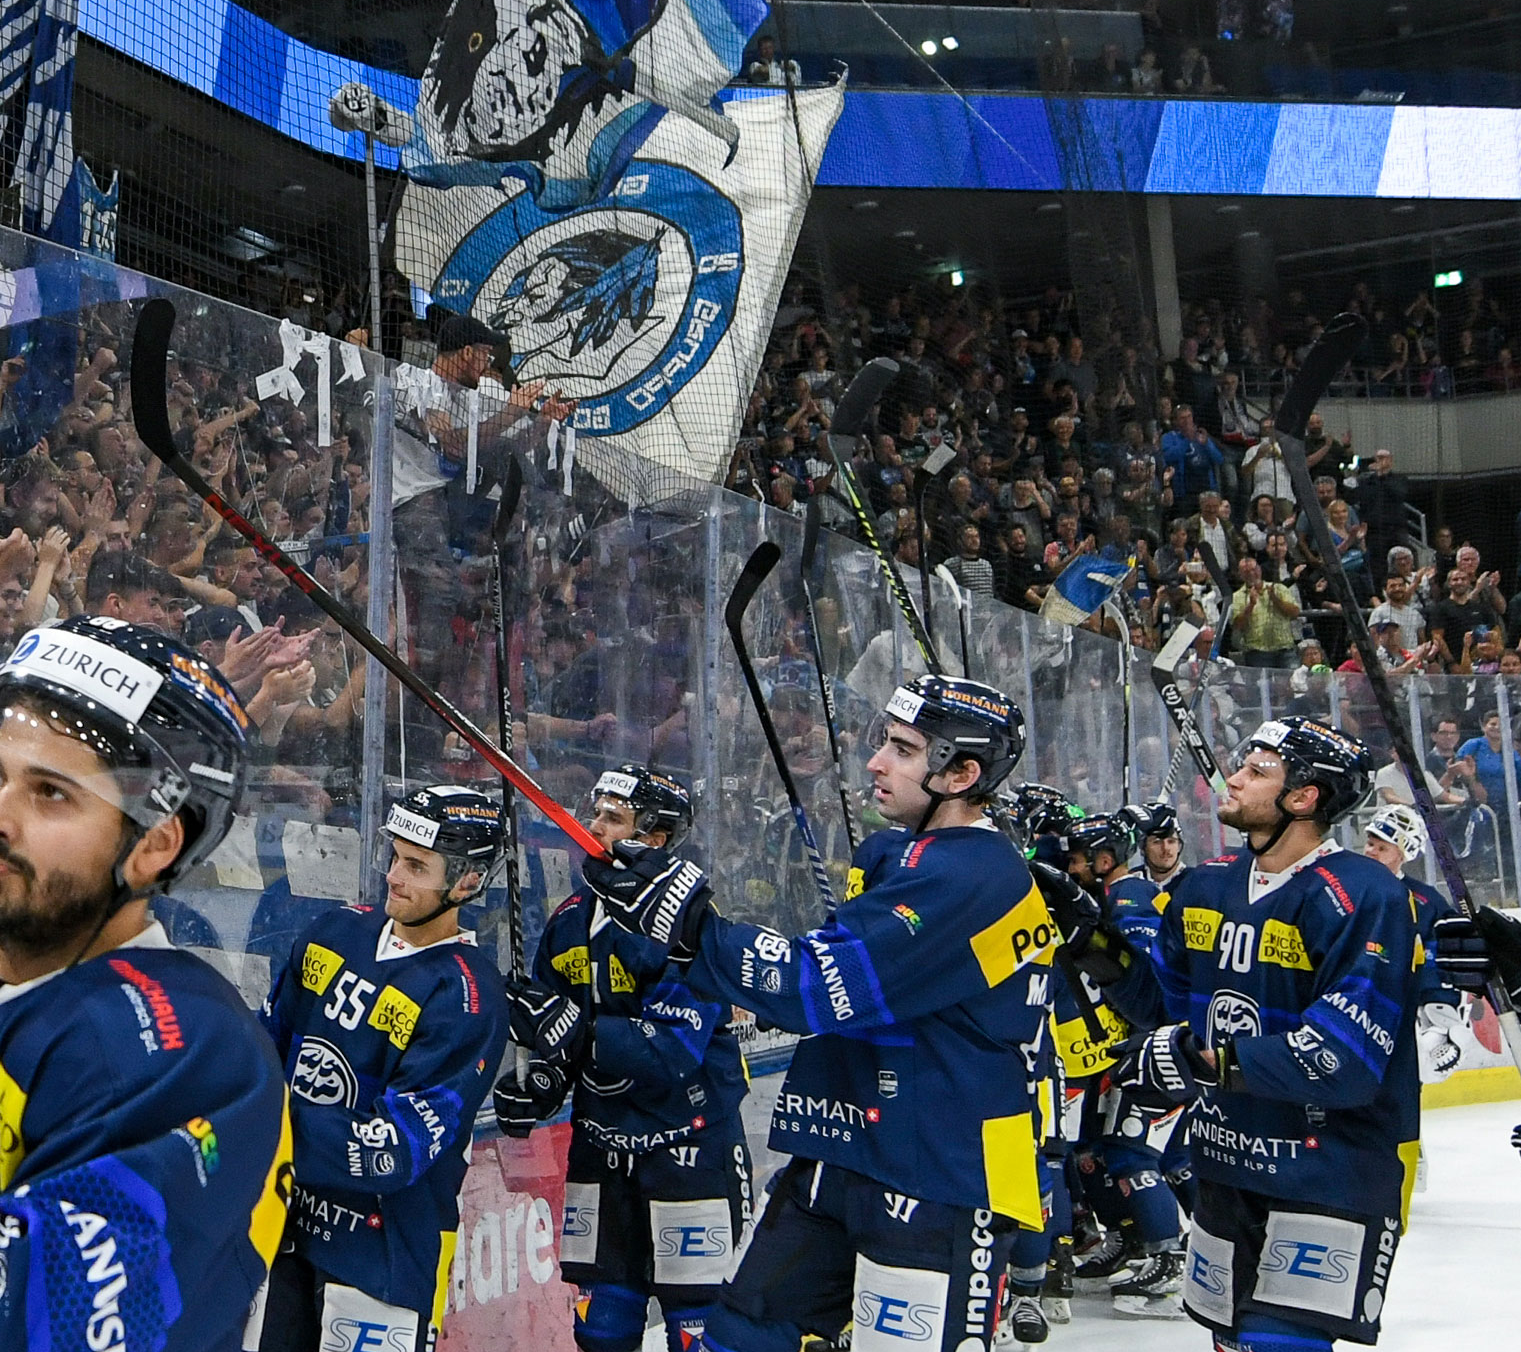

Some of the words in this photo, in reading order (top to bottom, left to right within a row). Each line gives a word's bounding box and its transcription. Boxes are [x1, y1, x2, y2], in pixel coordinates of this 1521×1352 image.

[40, 643, 141, 700] ZURICH
[392, 813, 435, 840] ZURICH
[650, 859, 704, 945] WARRIOR
[1217, 920, 1257, 974] 90
[741, 948, 754, 989] ANNI
[323, 970, 376, 1030] 55
[809, 1123, 853, 1143] ALPS
[1190, 1119, 1302, 1161] ANDERMATT
[346, 1140, 364, 1178] ANNI
[1243, 1157, 1278, 1176] ALPS
[297, 1217, 333, 1242] ALPS
[562, 1205, 596, 1237] ES
[655, 1225, 730, 1258] SES
[964, 1209, 994, 1335] inpeco
[1261, 1238, 1358, 1284] SES
[856, 1289, 942, 1344] SES
